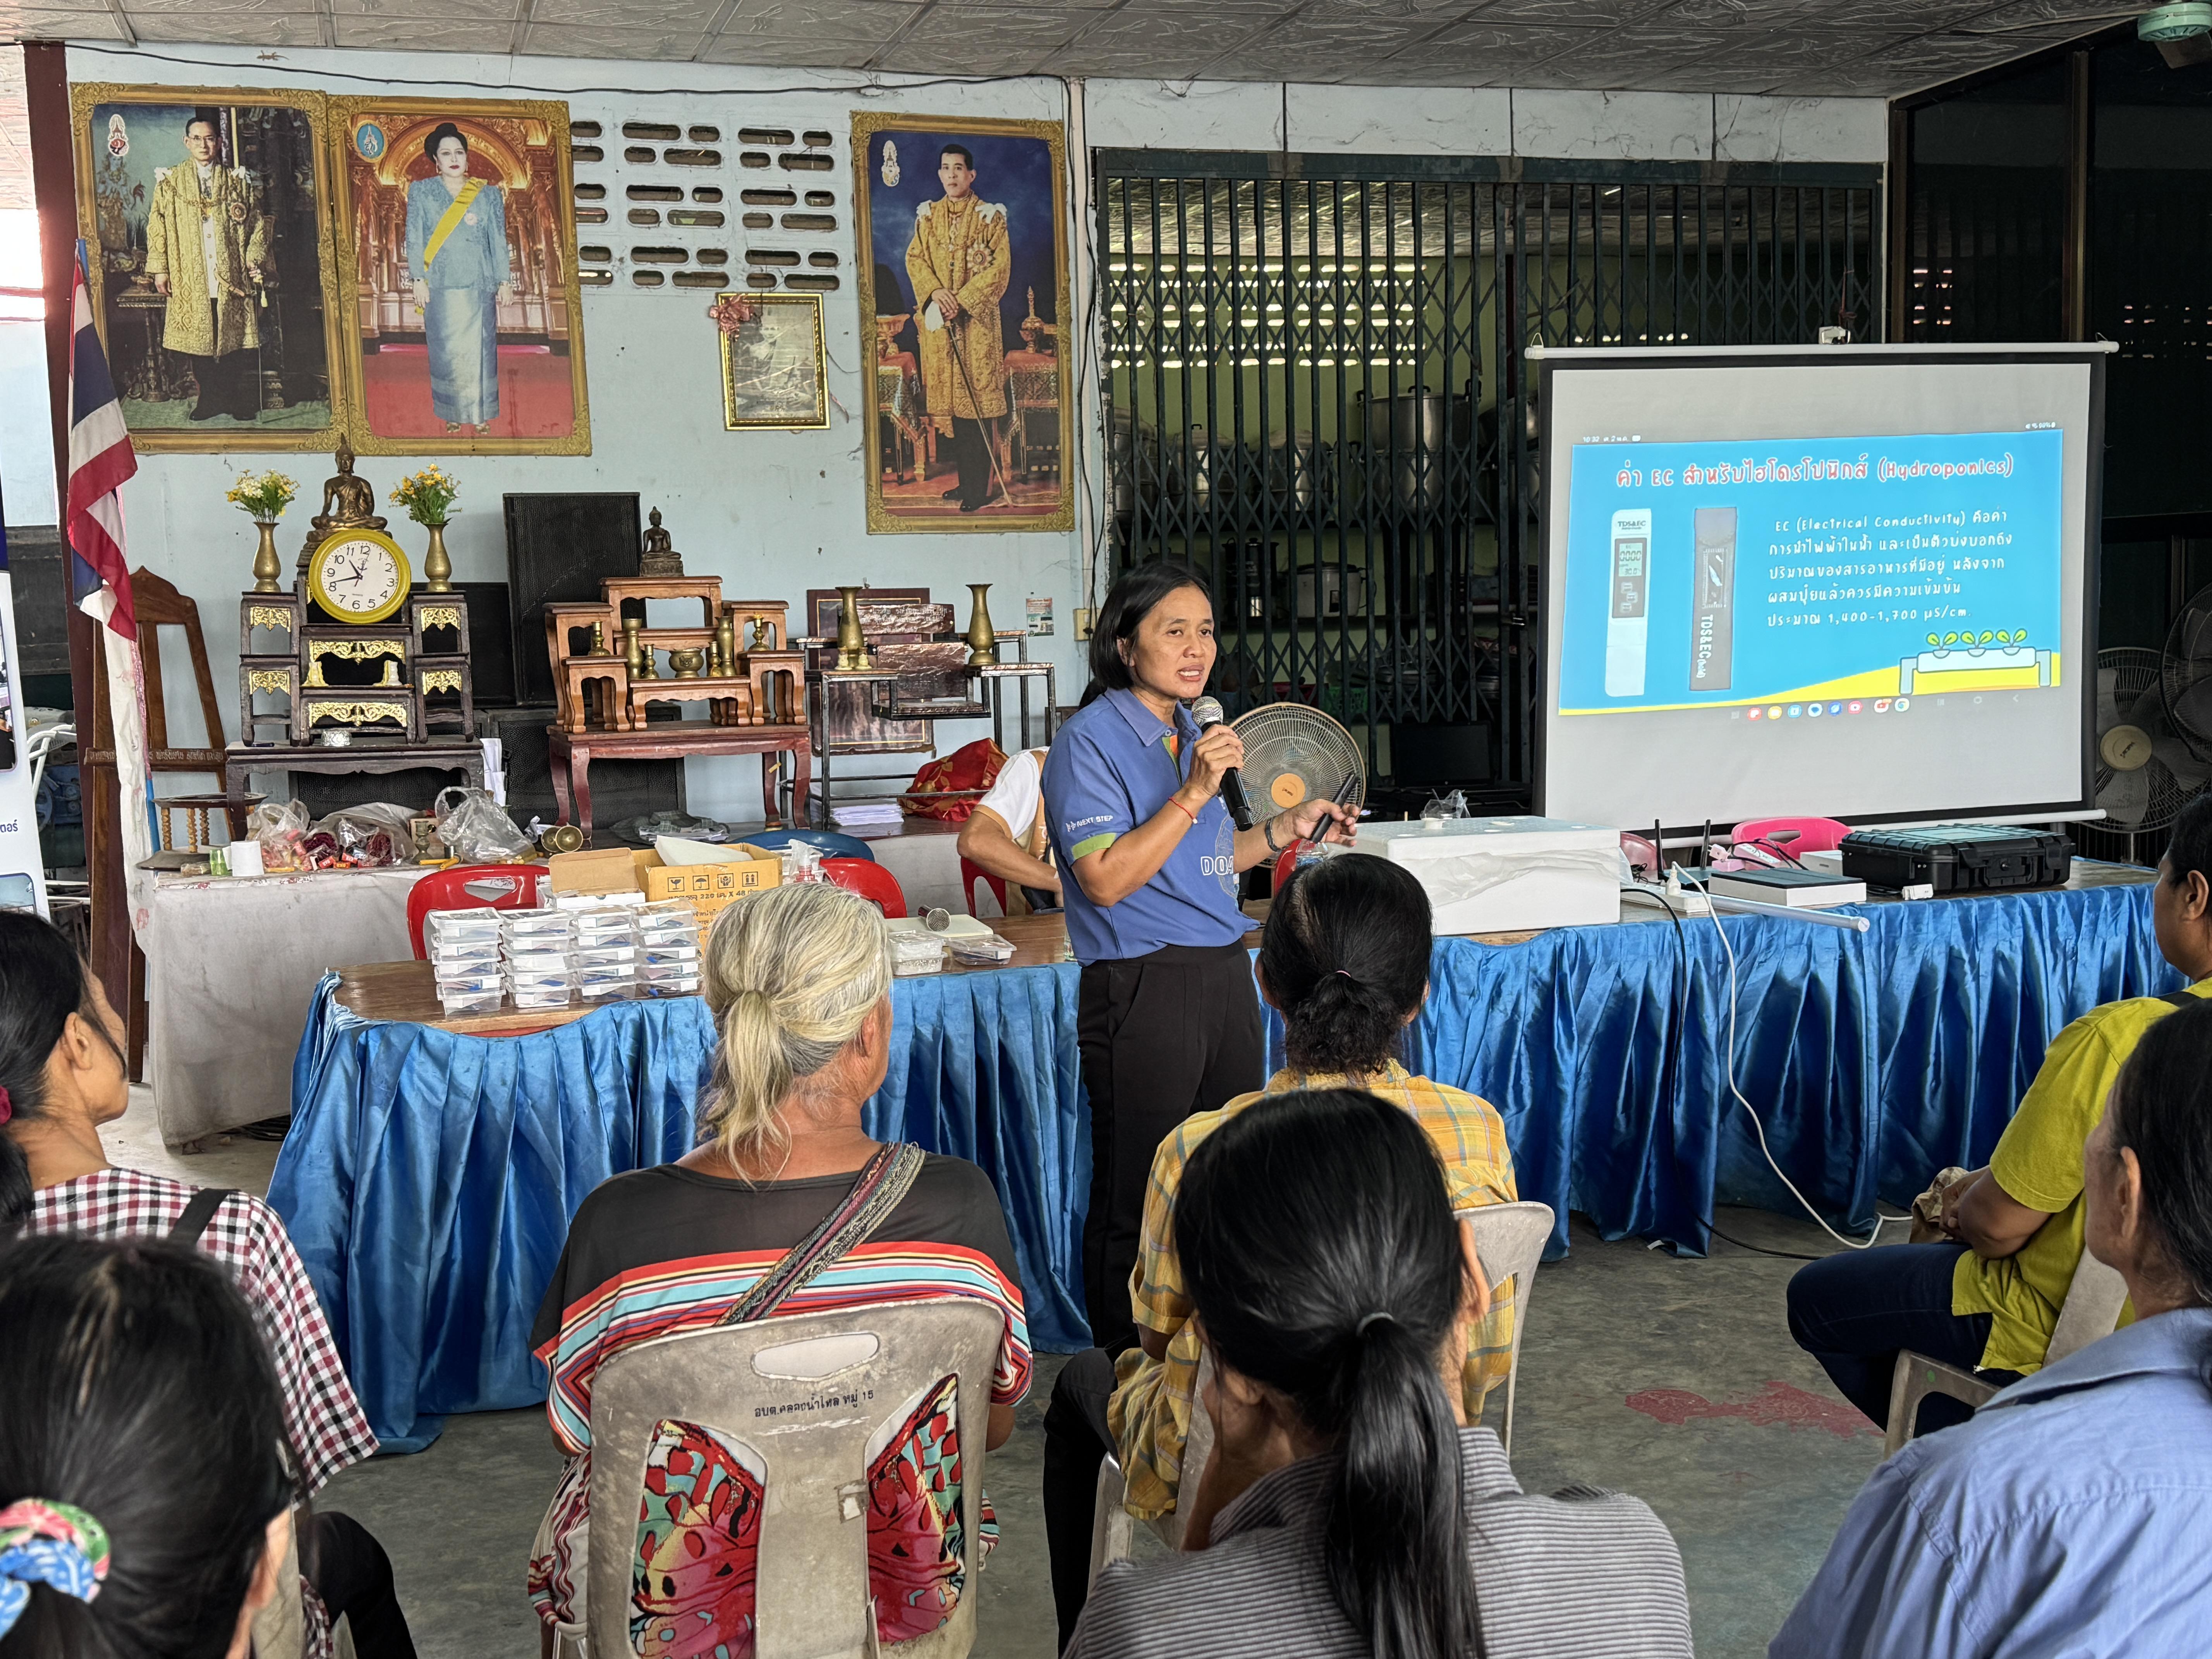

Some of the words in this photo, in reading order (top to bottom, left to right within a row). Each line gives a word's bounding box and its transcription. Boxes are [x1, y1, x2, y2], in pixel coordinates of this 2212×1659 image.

[1616, 460, 1642, 487] ค่า
[1651, 469, 1674, 486] EC
[1683, 453, 1869, 485] สำหรับไฮโดรโปนิกส์
[1877, 452, 2014, 482] (Hydroponics)
[1776, 521, 1790, 532] EC
[1796, 515, 1867, 533] (Electrical
[1874, 510, 1966, 527] Conductivity)
[1769, 534, 1872, 555] การนำไฟฟ้าในน้ำ
[1879, 530, 2013, 551] และเป็นตัวบ่งบอกถึง
[347, 546, 354, 556] 11
[361, 545, 370, 555] 12
[334, 555, 345, 565] 10
[378, 552, 382, 561] 1
[385, 563, 393, 572] 2
[1769, 554, 1946, 580] ปริมาณของสารอาหารที่มีอยู่
[1953, 556, 2005, 570] หลังจาก
[327, 568, 335, 577] 9
[329, 581, 337, 592] 8
[386, 578, 395, 587] 3
[380, 590, 388, 599] 4
[1768, 577, 1961, 606] ผสมปุ๋ยแล้วควรมีความเข้มข้น
[339, 594, 346, 603] 7
[368, 599, 376, 608] 5
[352, 600, 360, 610] 6
[1767, 613, 1821, 627] ประมาณ
[1828, 609, 1917, 625] 1,400-1,700
[1698, 614, 1714, 658] TDS&EC
[1077, 817, 1094, 827] NEXT
[843, 1389, 858, 1408] หมู่
[862, 1389, 874, 1401] 15
